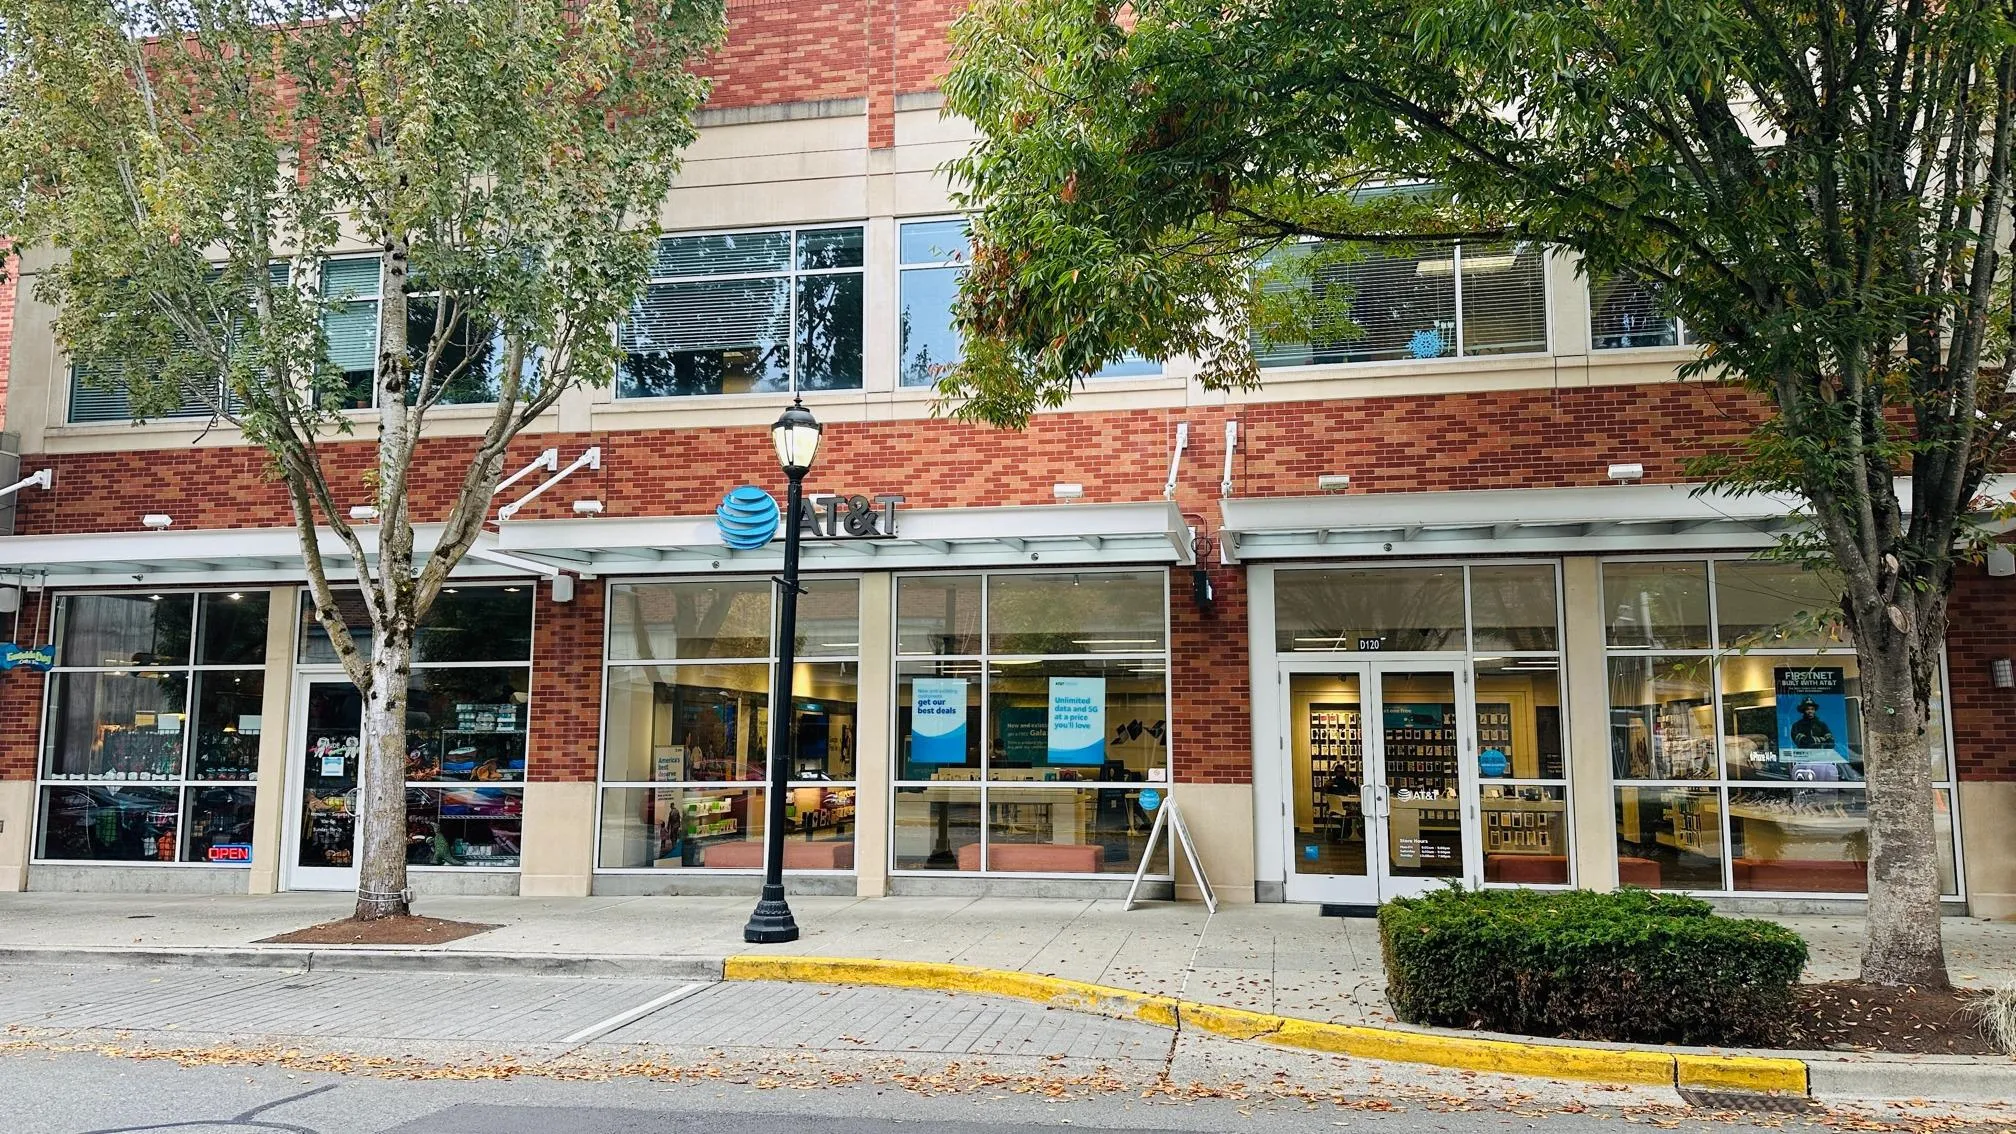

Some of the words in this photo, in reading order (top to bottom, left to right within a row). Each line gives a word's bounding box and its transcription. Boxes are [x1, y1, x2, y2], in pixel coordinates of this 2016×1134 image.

[799, 495, 905, 537] AT&T
[1360, 640, 1380, 650] D120
[1784, 671, 1834, 680] FIRSTNET
[918, 699, 931, 707] get
[1070, 714, 1088, 722] price
[1054, 722, 1074, 730] you'll
[1029, 729, 1048, 737] Gala
[1413, 791, 1437, 800] AT&T
[208, 847, 249, 860] OPEN
